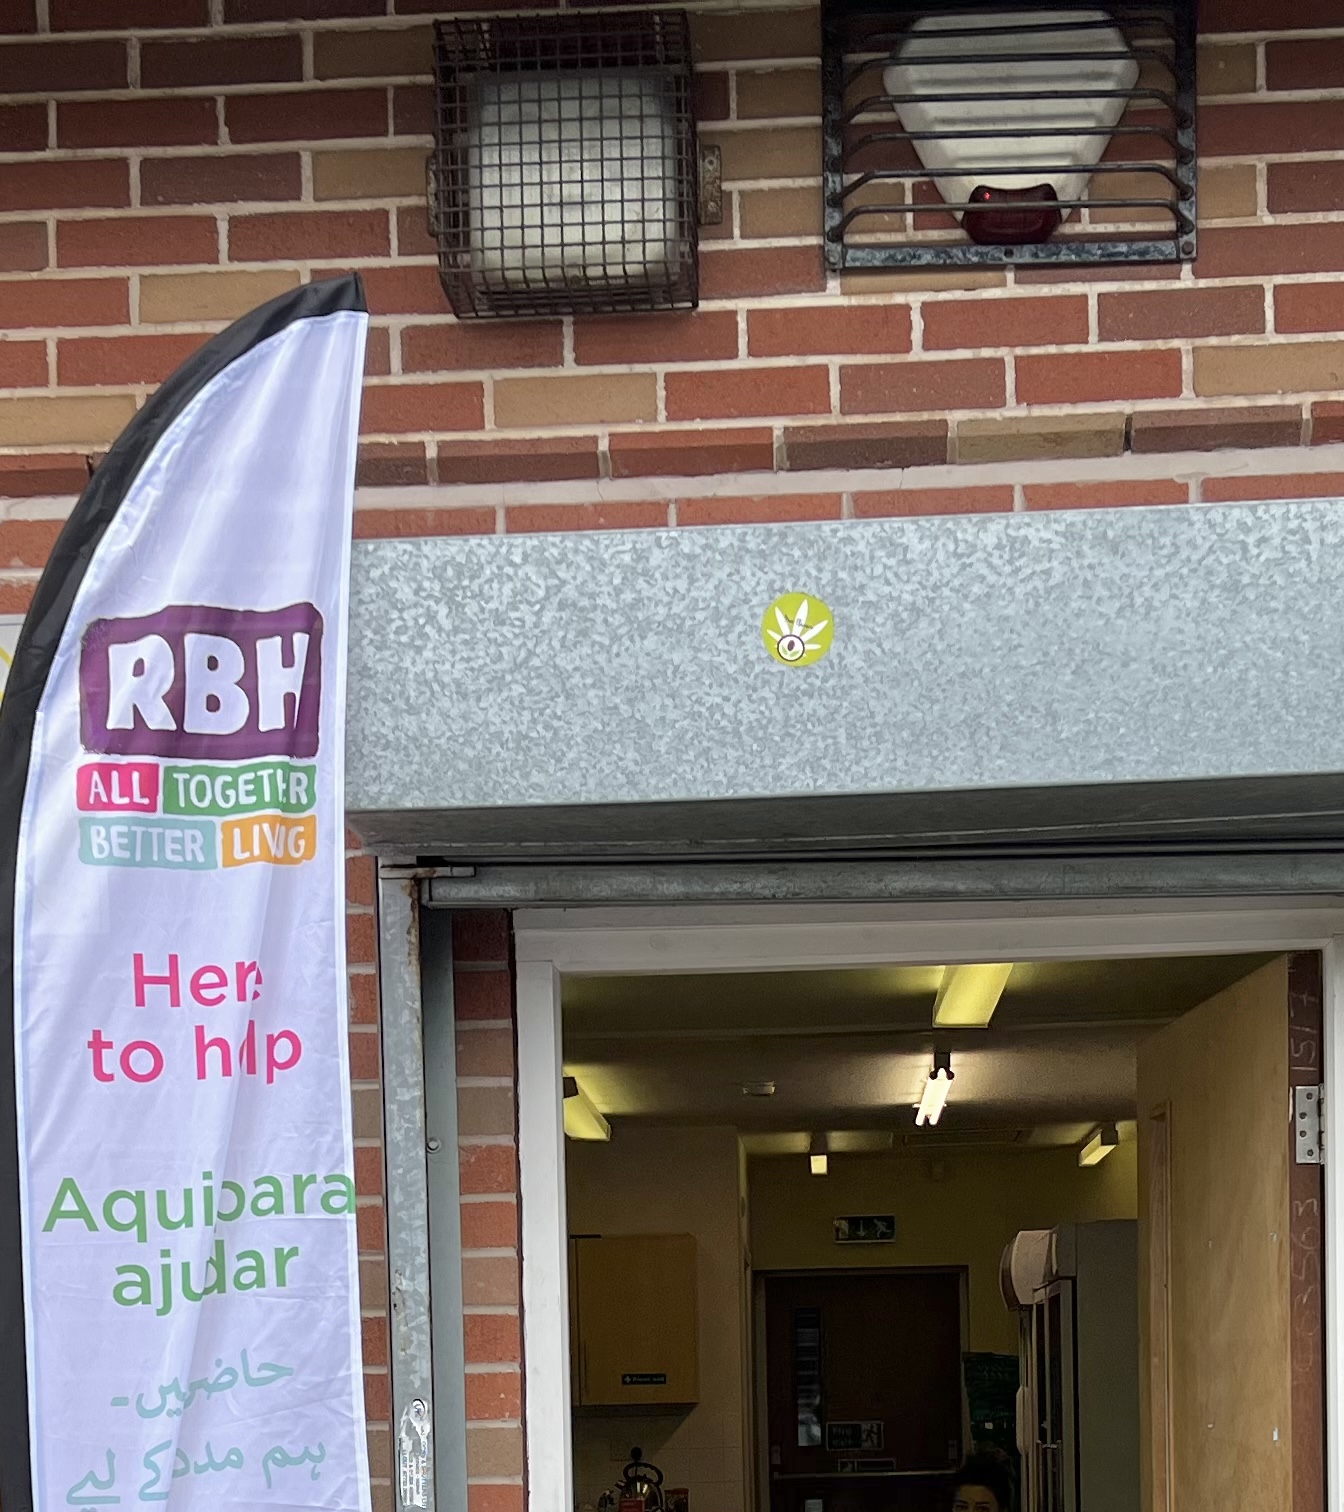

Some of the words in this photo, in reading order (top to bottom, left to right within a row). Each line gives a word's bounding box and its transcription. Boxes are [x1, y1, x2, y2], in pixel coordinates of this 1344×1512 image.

[106, 631, 310, 734] RBH
[88, 769, 150, 806] ALL
[173, 768, 308, 809] TOGETHR
[90, 824, 205, 862] BETTER
[132, 953, 263, 1008] Her
[87, 1029, 165, 1083] to
[194, 1019, 302, 1085] hlp
[42, 1170, 214, 1243] Aqui
[112, 1239, 299, 1317] ajudar
